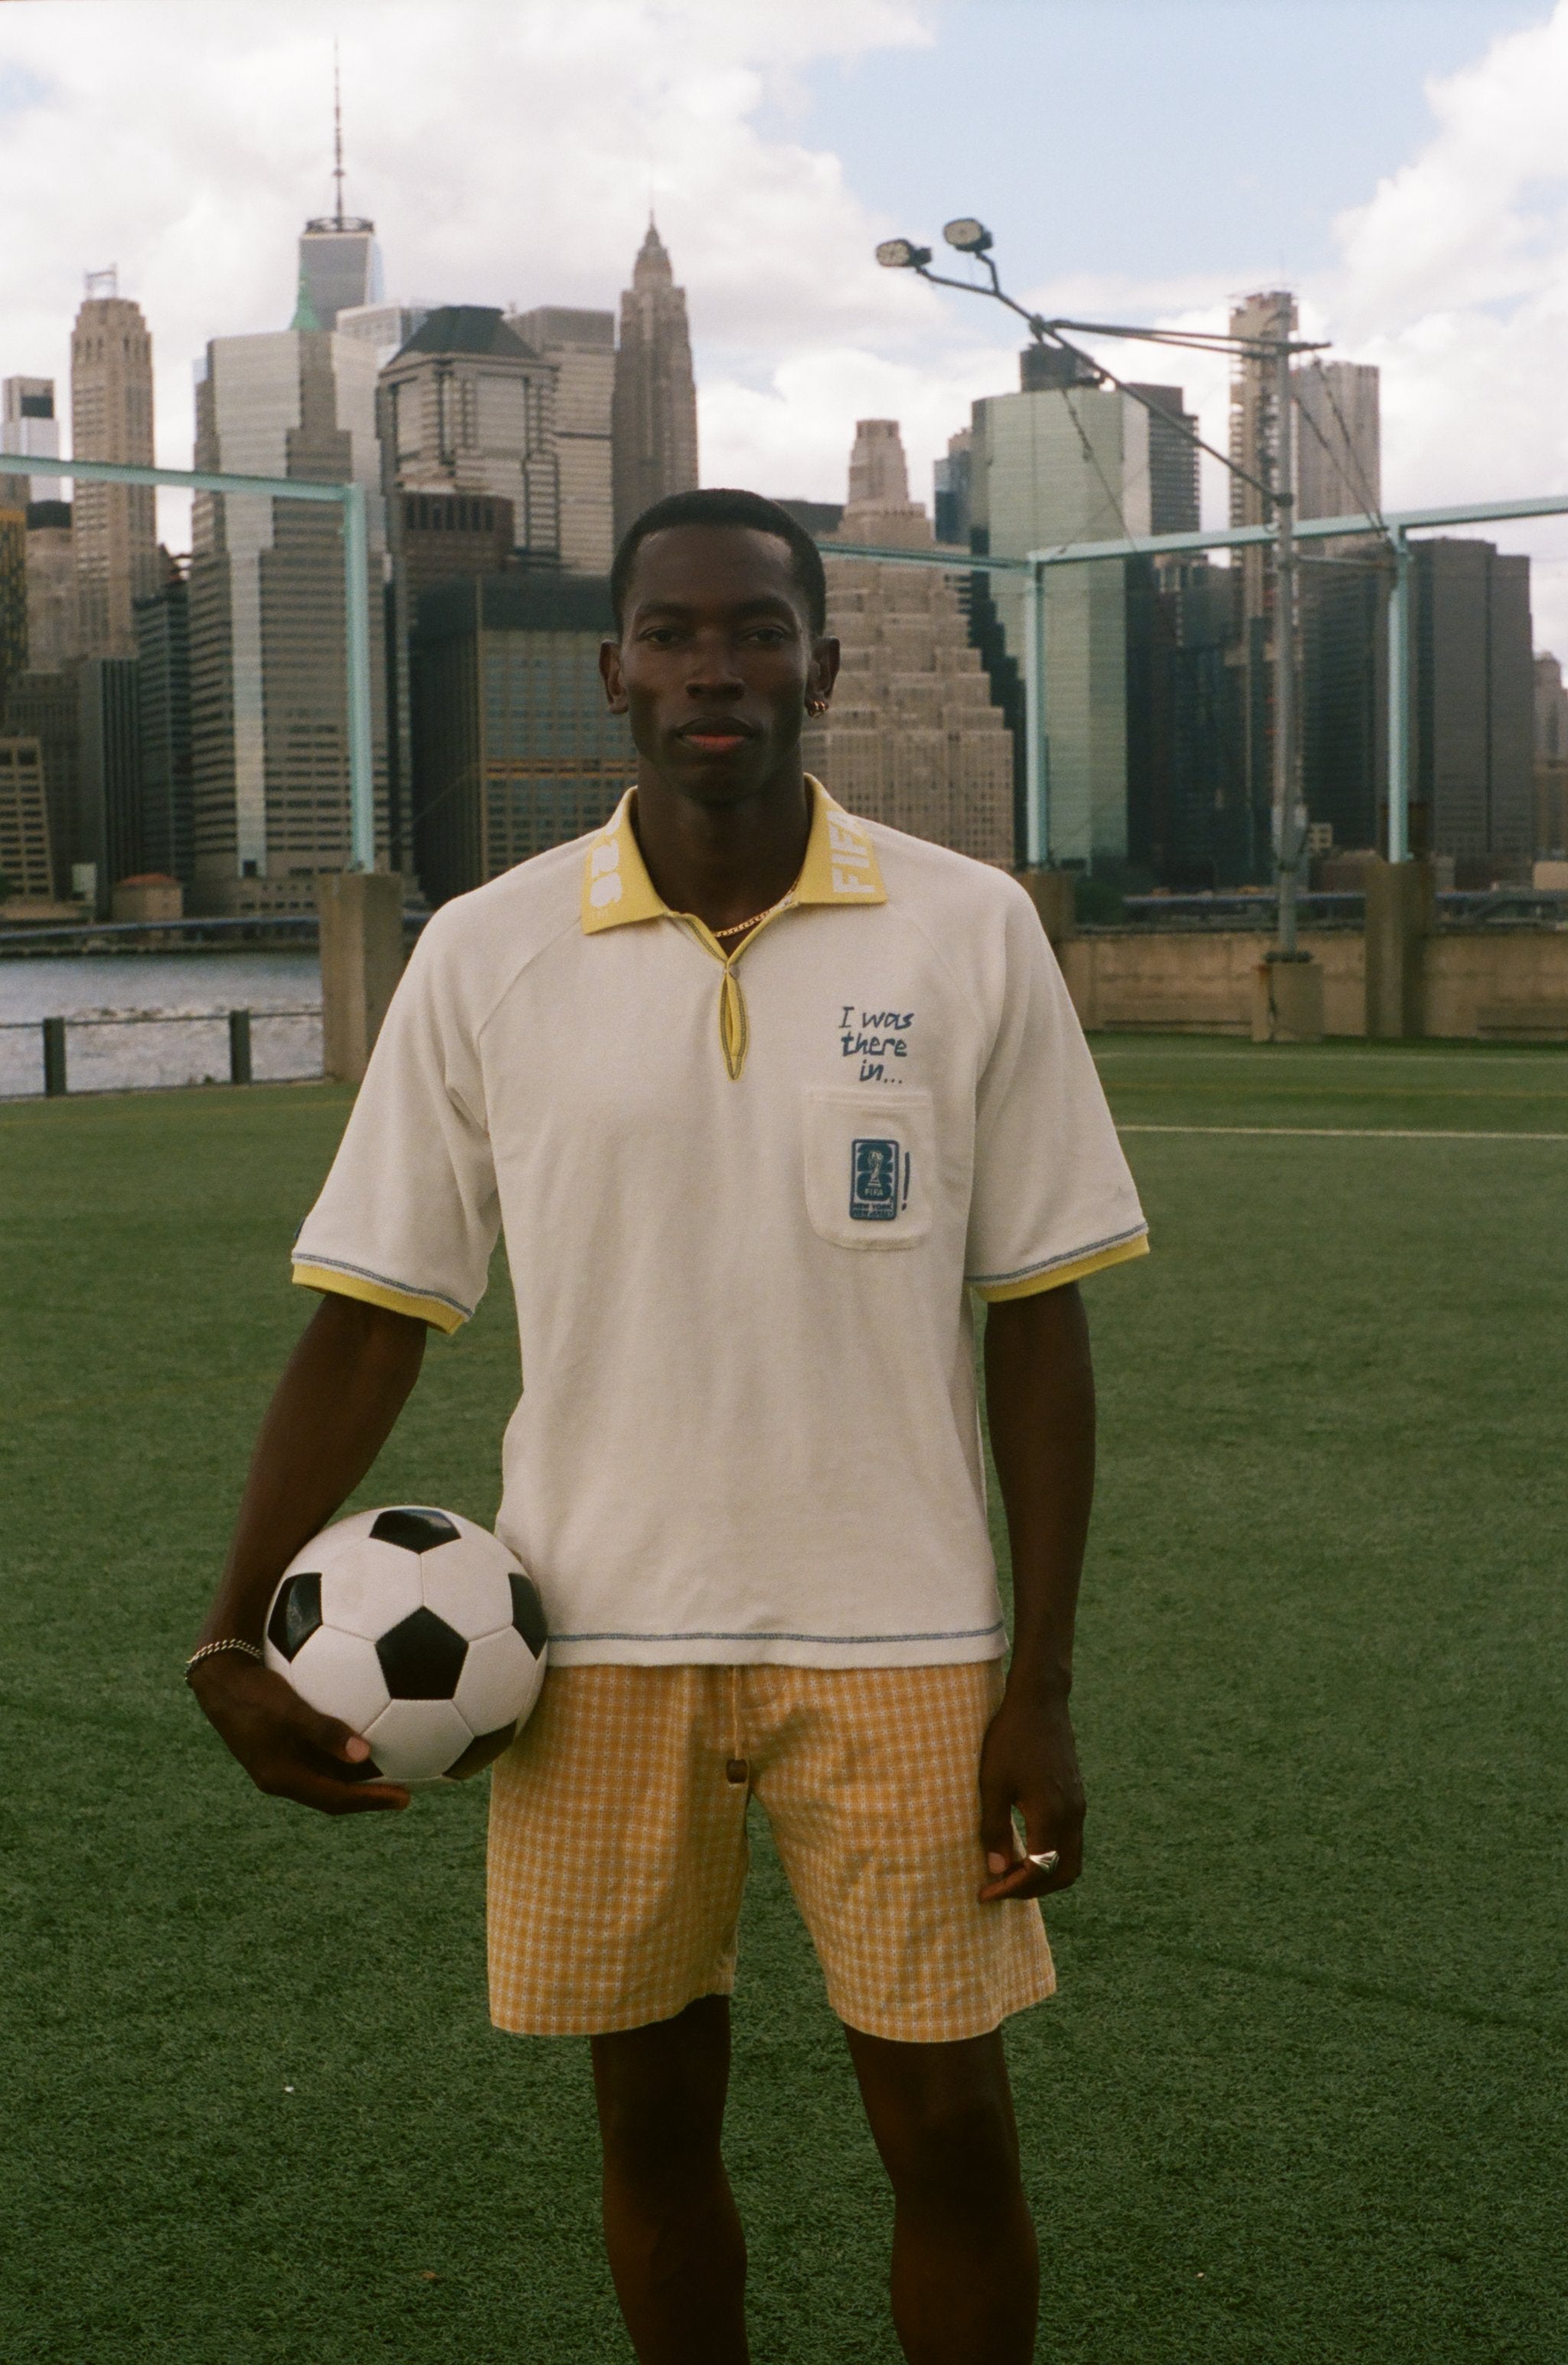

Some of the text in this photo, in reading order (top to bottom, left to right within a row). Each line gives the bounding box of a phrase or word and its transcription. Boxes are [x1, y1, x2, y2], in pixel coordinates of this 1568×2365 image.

[826, 810, 876, 893] FIFA
[838, 1006, 915, 1031] I was
[841, 1031, 908, 1057] there
[859, 1059, 903, 1083] in...
[864, 1187, 884, 1196] FIFA
